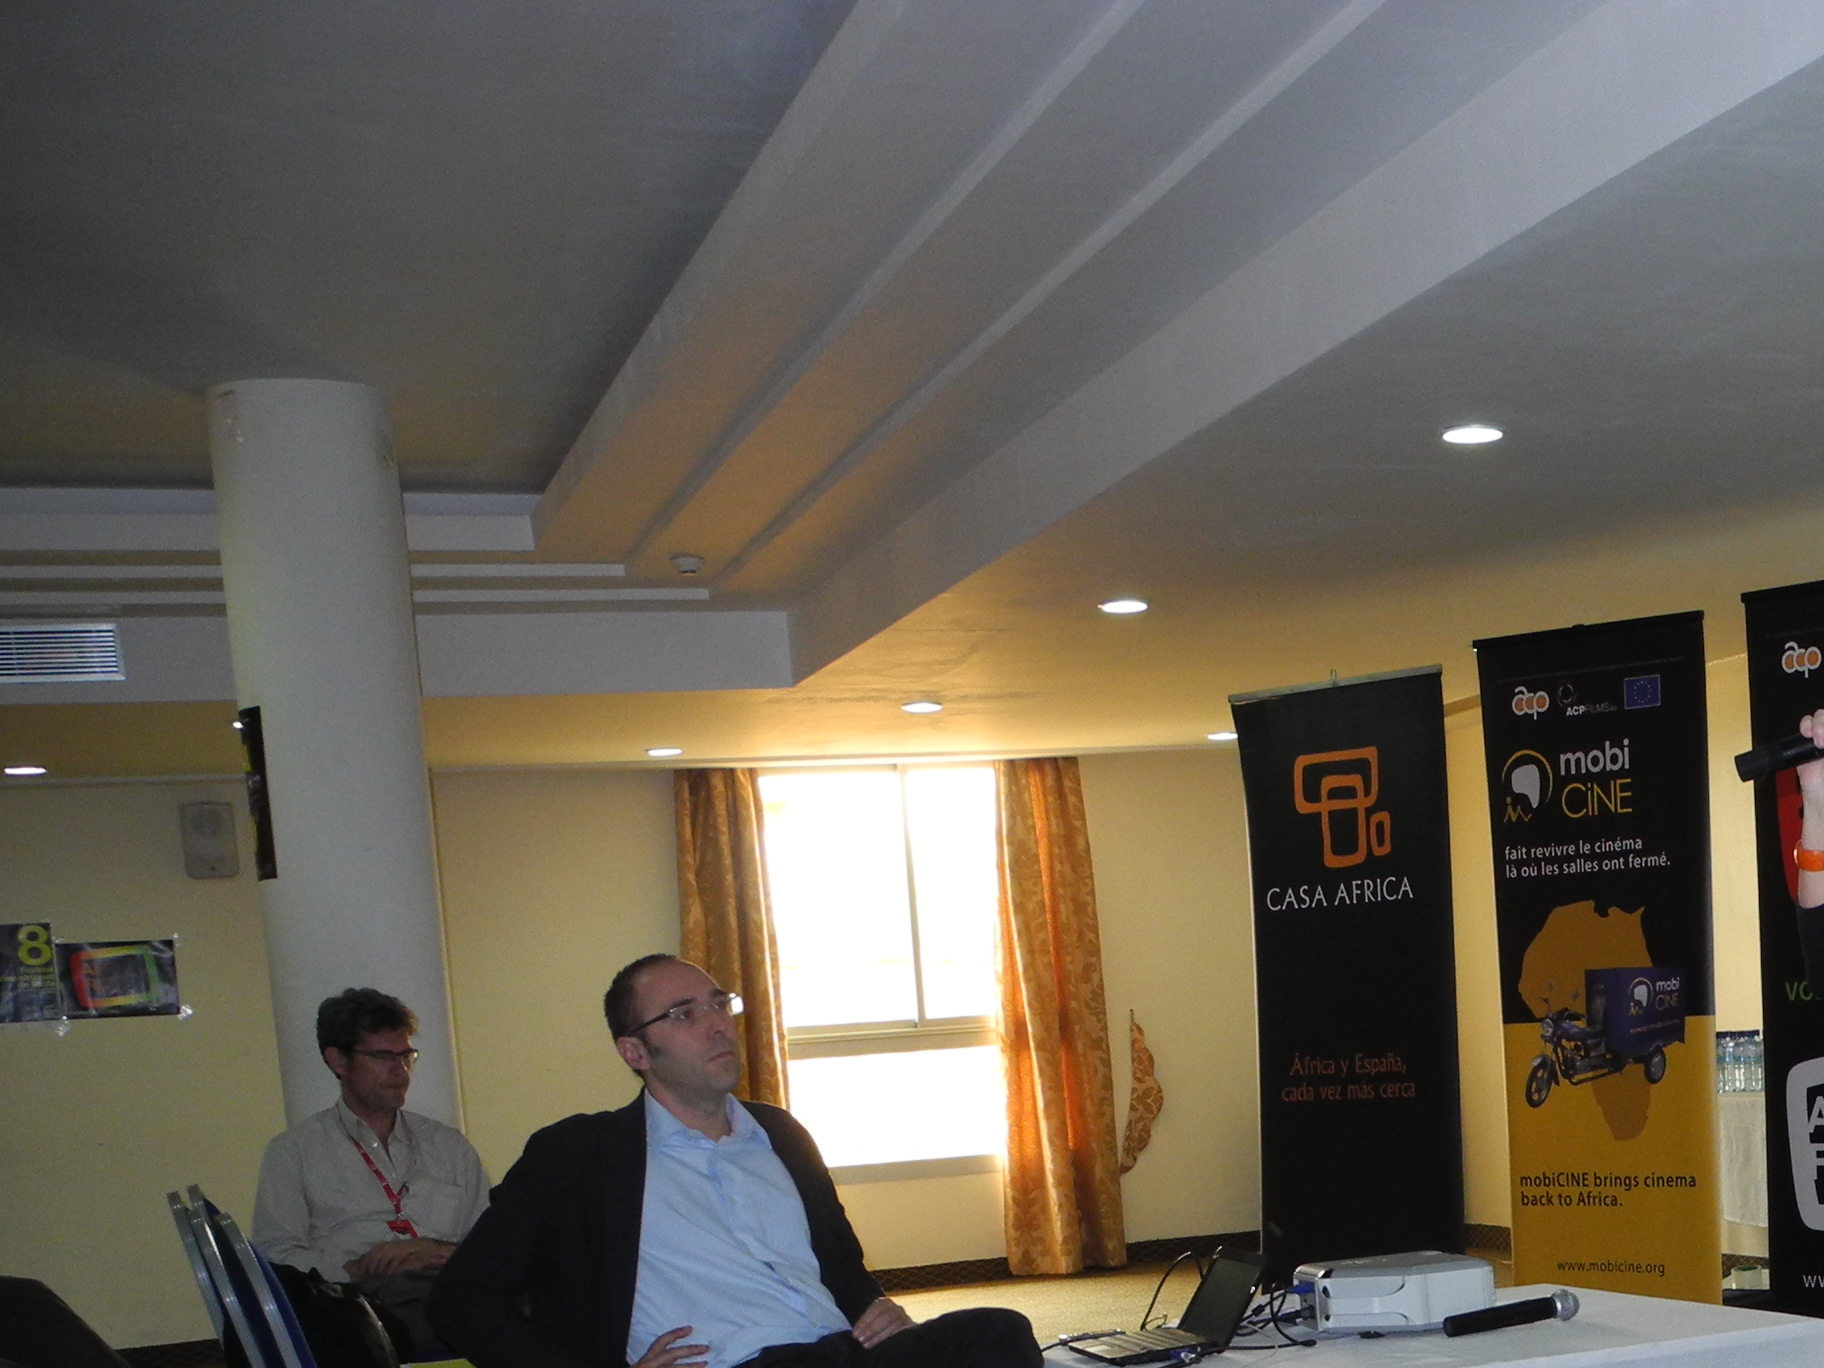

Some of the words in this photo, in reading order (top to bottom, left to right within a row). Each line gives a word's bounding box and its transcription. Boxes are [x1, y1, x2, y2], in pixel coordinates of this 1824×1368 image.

[1560, 738, 1630, 776] mobi
[1505, 846, 1527, 860] fait
[1531, 843, 1576, 858] revivre
[1579, 840, 1591, 854] le
[1594, 837, 1642, 852] cinéma
[1506, 864, 1518, 878] là
[1521, 862, 1538, 877] où
[1541, 861, 1559, 876] les
[1563, 859, 1599, 874] salles
[1602, 857, 1624, 872] ont
[1628, 851, 1671, 869] fermé.
[1266, 883, 1328, 912] CASA
[1334, 876, 1414, 906] AFRICA
[18, 925, 52, 966] 8
[1290, 1052, 1335, 1077] África
[1340, 1059, 1349, 1077] y
[1282, 1082, 1314, 1102] cada
[1319, 1084, 1342, 1101] vez
[1346, 1079, 1375, 1100] más
[1380, 1080, 1416, 1099] cerca
[1519, 1171, 1589, 1188] mobiCINE
[1593, 1171, 1640, 1190] brings
[1643, 1172, 1696, 1188] cinema
[1521, 1191, 1554, 1207] back
[1559, 1192, 1573, 1207] to
[1577, 1191, 1623, 1207] Africa.
[1556, 1259, 1666, 1278] www.mobicine.org
